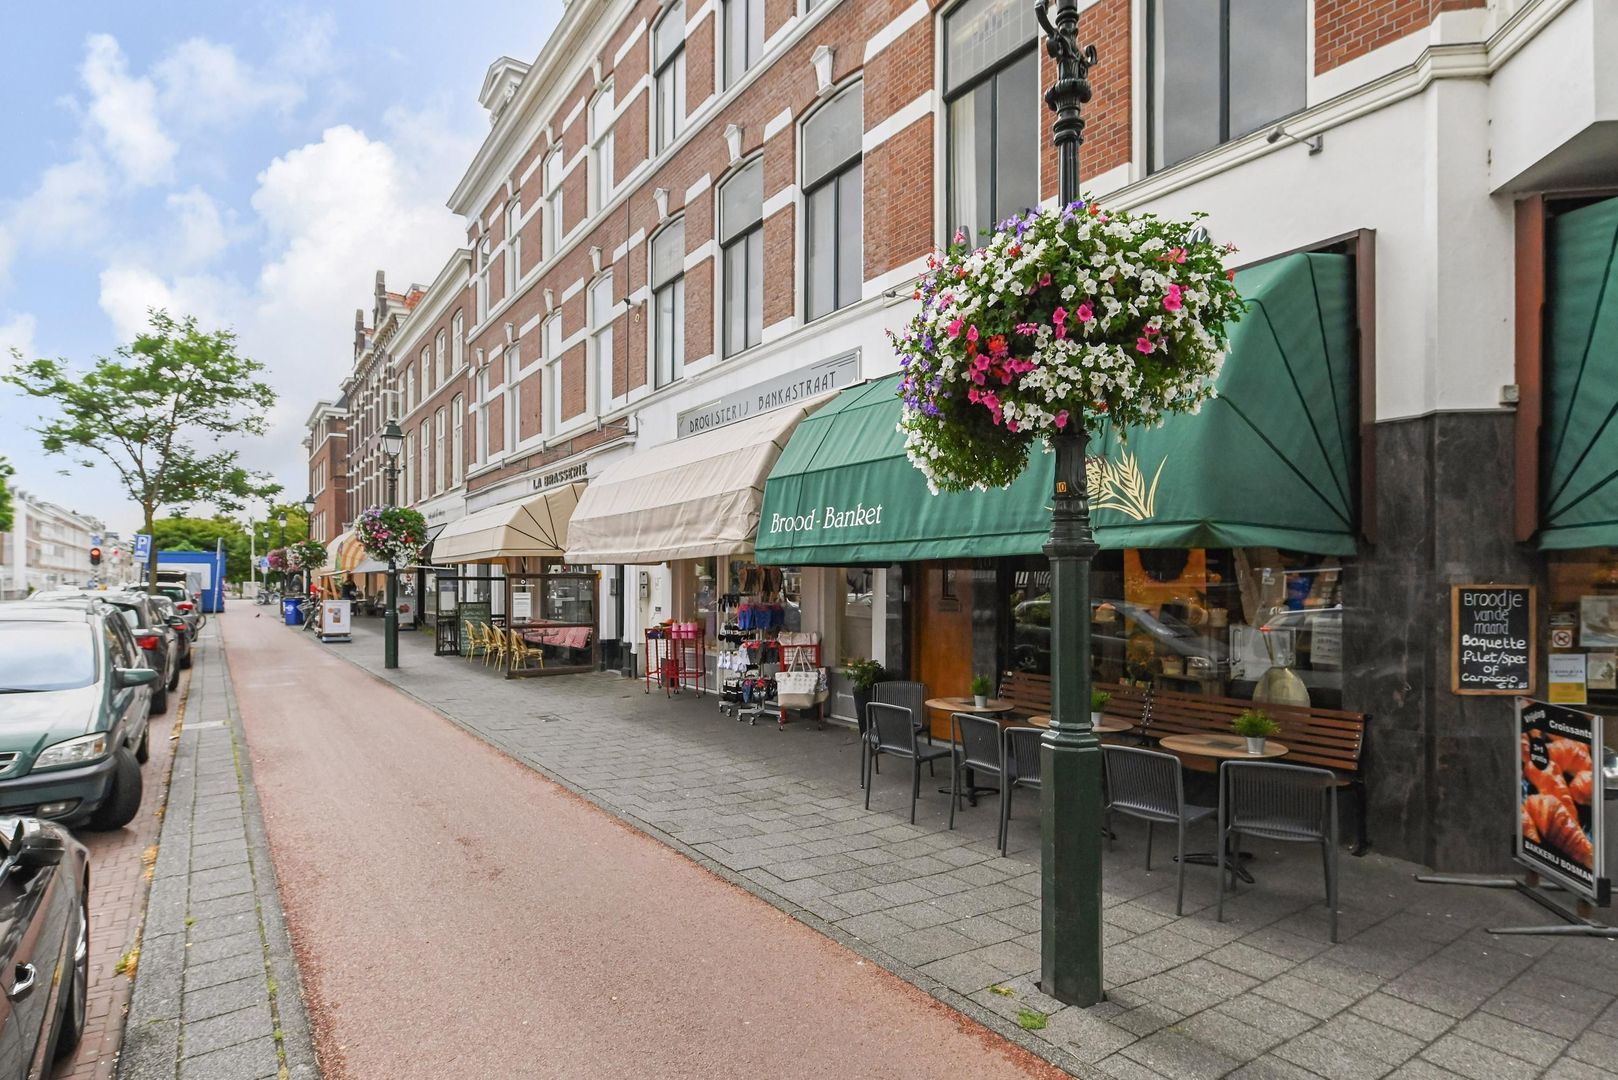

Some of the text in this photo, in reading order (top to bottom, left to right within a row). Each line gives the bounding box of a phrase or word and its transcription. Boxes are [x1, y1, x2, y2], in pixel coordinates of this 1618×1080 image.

[689, 371, 837, 433] DROGISTERIJ BANKASTRAAT
[533, 462, 588, 490] LA BRASSERIE
[137, 536, 148, 549] P
[1464, 590, 1523, 612] Broodje
[1473, 620, 1509, 635] maand
[1461, 672, 1519, 684] Carpaccio
[1483, 665, 1500, 676] of
[1548, 720, 1593, 739] Croissants
[1524, 840, 1594, 883] BAKKERIJ BOSMAN
